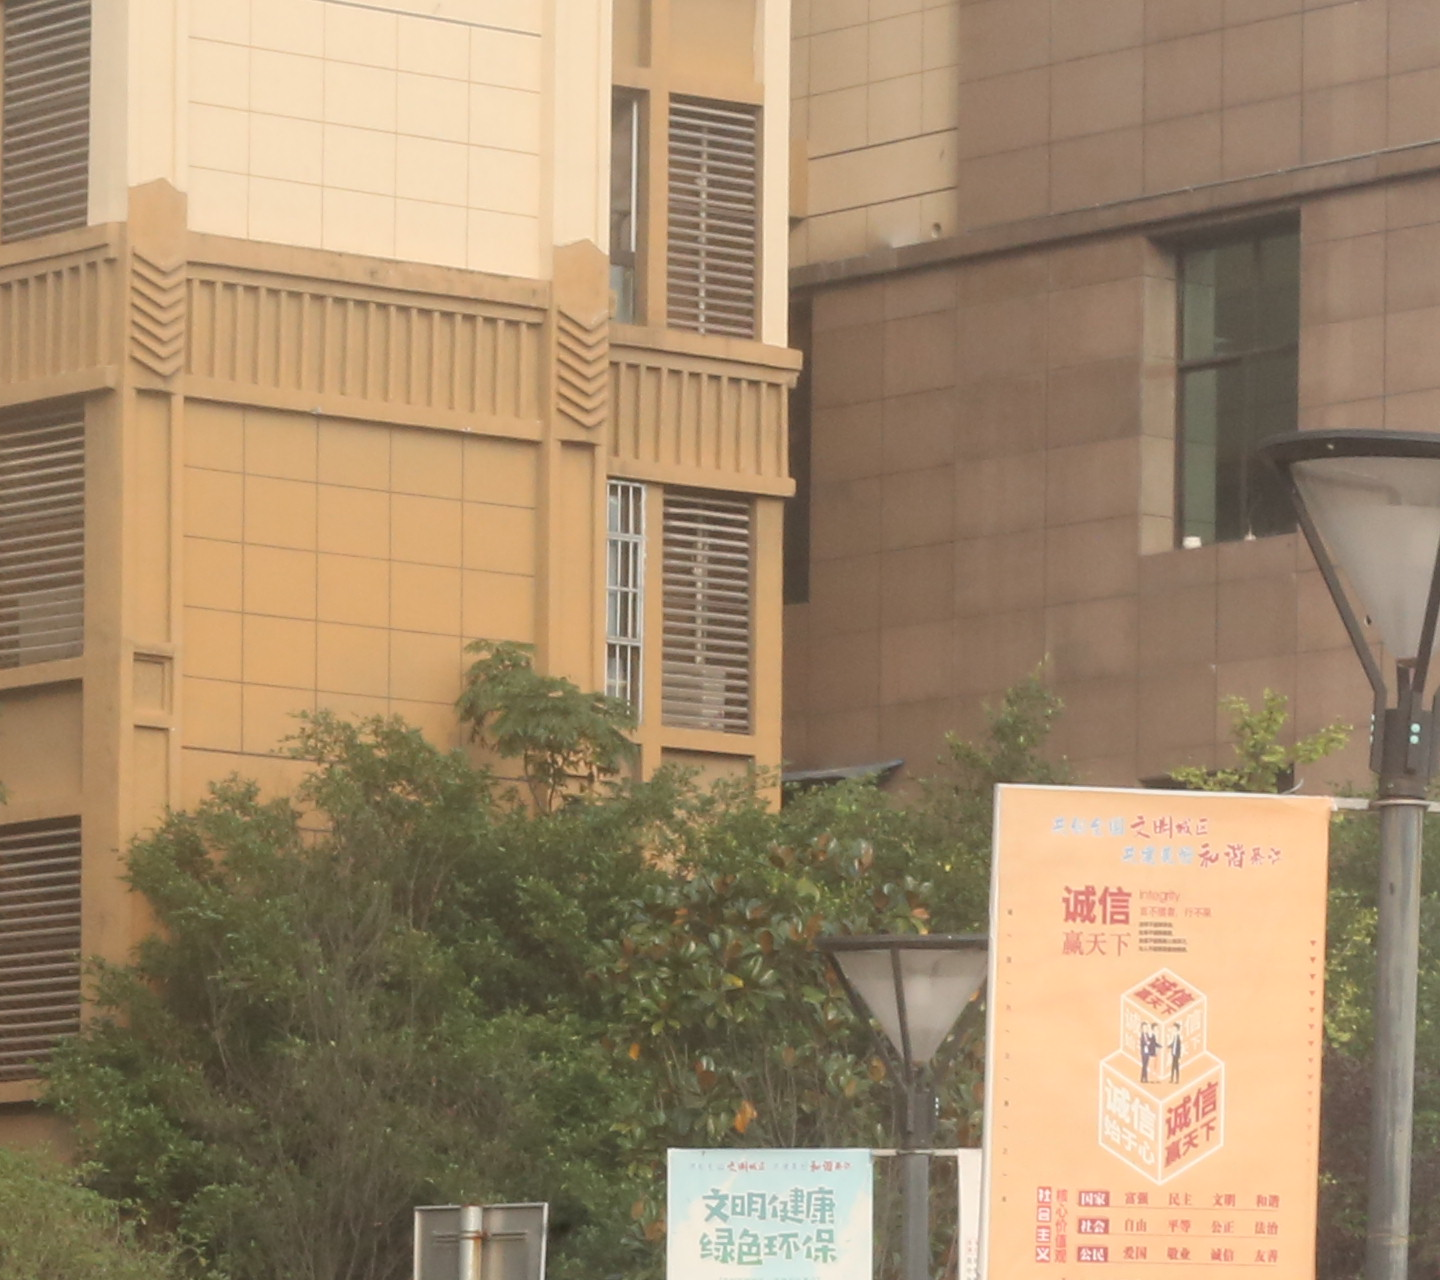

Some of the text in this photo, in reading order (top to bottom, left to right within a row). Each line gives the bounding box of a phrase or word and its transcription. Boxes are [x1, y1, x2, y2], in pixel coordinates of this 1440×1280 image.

[1062, 884, 1133, 926] 诚信
[1062, 930, 1132, 957] 赢天下
[1148, 976, 1195, 1008] 诚信
[1105, 1079, 1157, 1141] 诚信
[1165, 1082, 1218, 1140] 诚信
[1103, 1116, 1155, 1166] 始于心
[702, 1186, 836, 1225] 文明健康
[1080, 1191, 1280, 1208] 国家 富强 民主 文明 和谐
[699, 1226, 838, 1266] 绿色环保
[1080, 1218, 1279, 1235] 社会 自由 平等 公正 法治
[1079, 1246, 1279, 1263] 公民 爱国 敬业 诚信 友善
